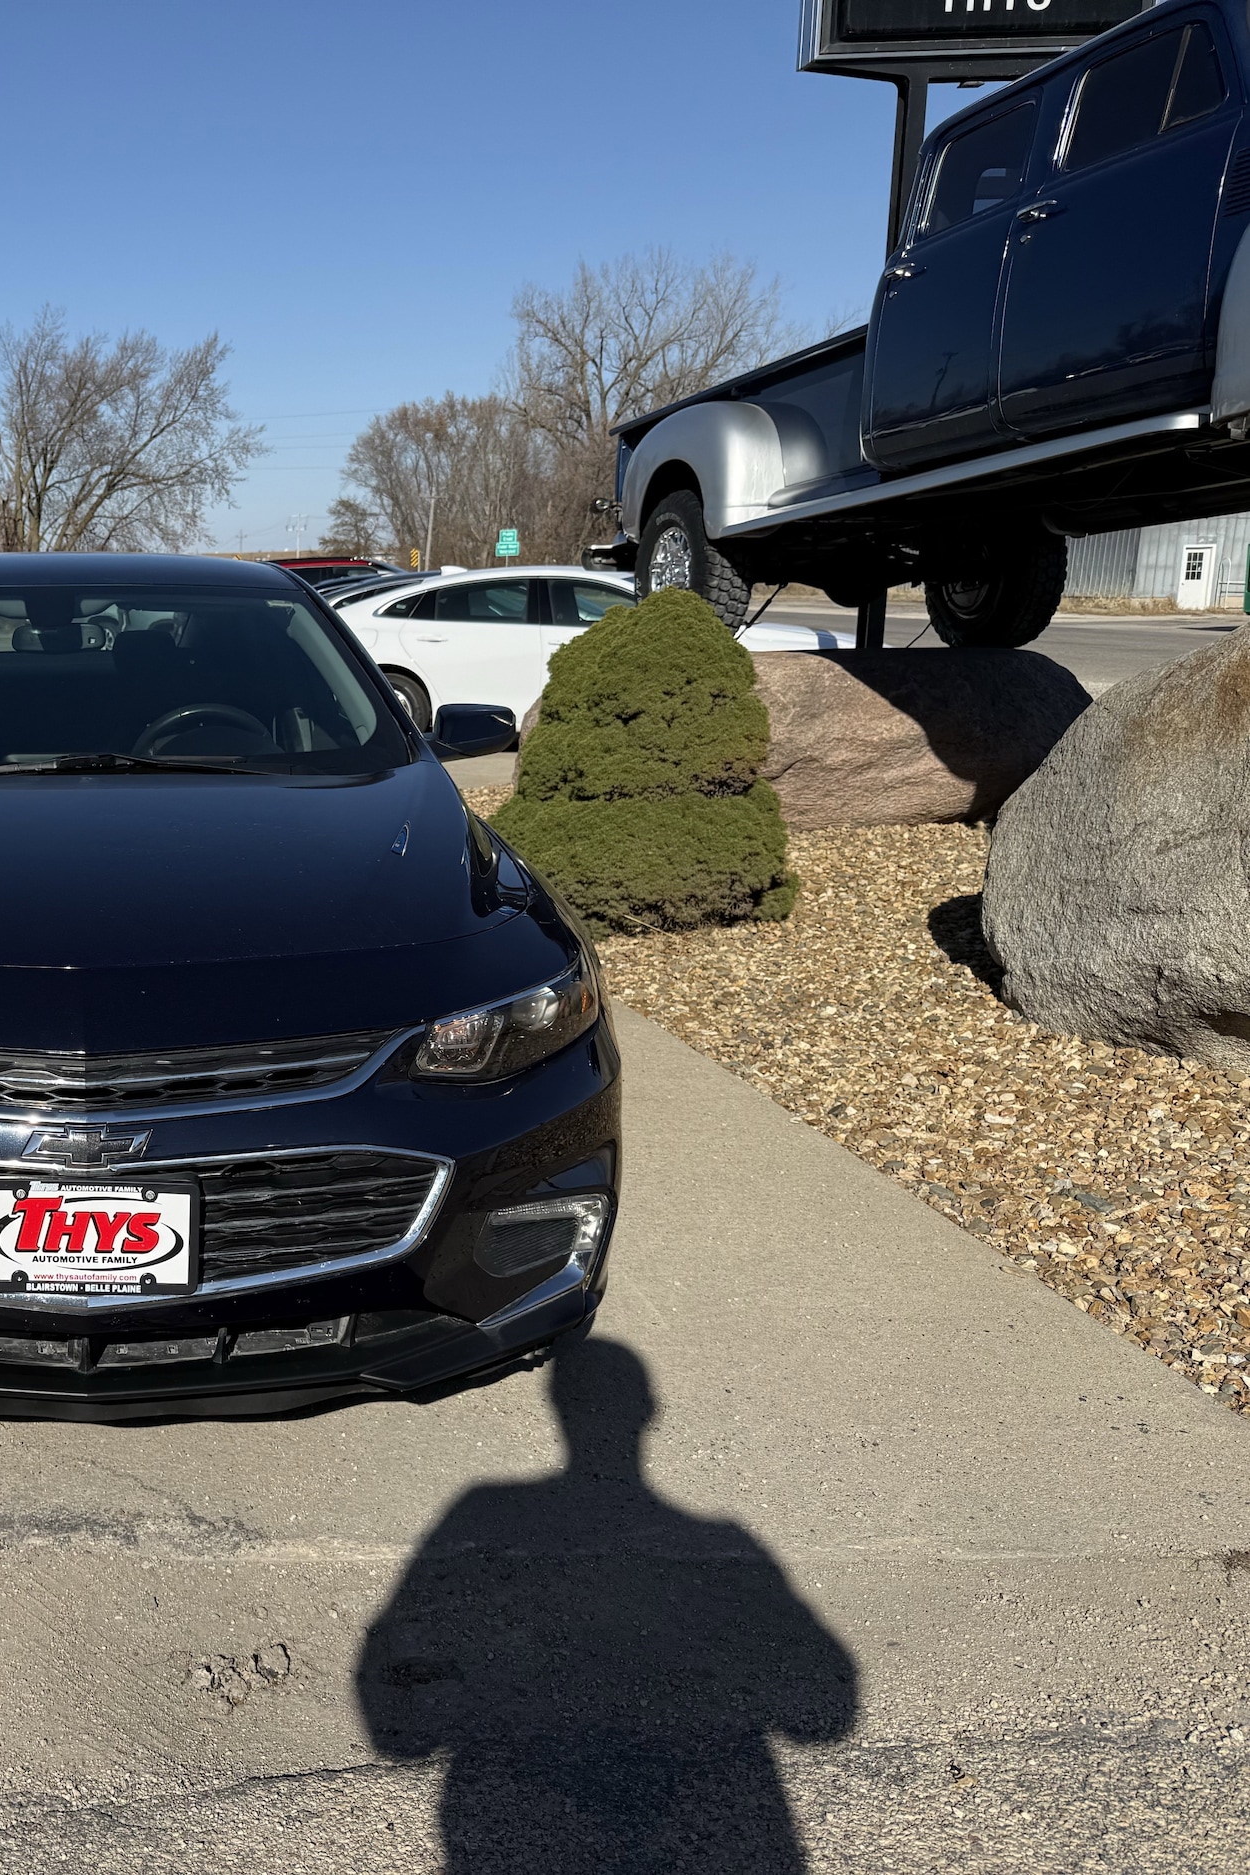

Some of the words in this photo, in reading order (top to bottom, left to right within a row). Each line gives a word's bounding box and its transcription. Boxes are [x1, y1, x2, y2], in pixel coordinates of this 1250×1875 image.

[13, 1196, 161, 1253] THYS
[32, 1255, 99, 1264] AUTOMOTIVE
[102, 1256, 138, 1264] FAMILY
[33, 1273, 137, 1283] www.thysautofamily.com
[26, 1282, 79, 1292] BLAIRSTOWN
[84, 1284, 111, 1293] BELLE
[112, 1284, 142, 1294] PLAINE
